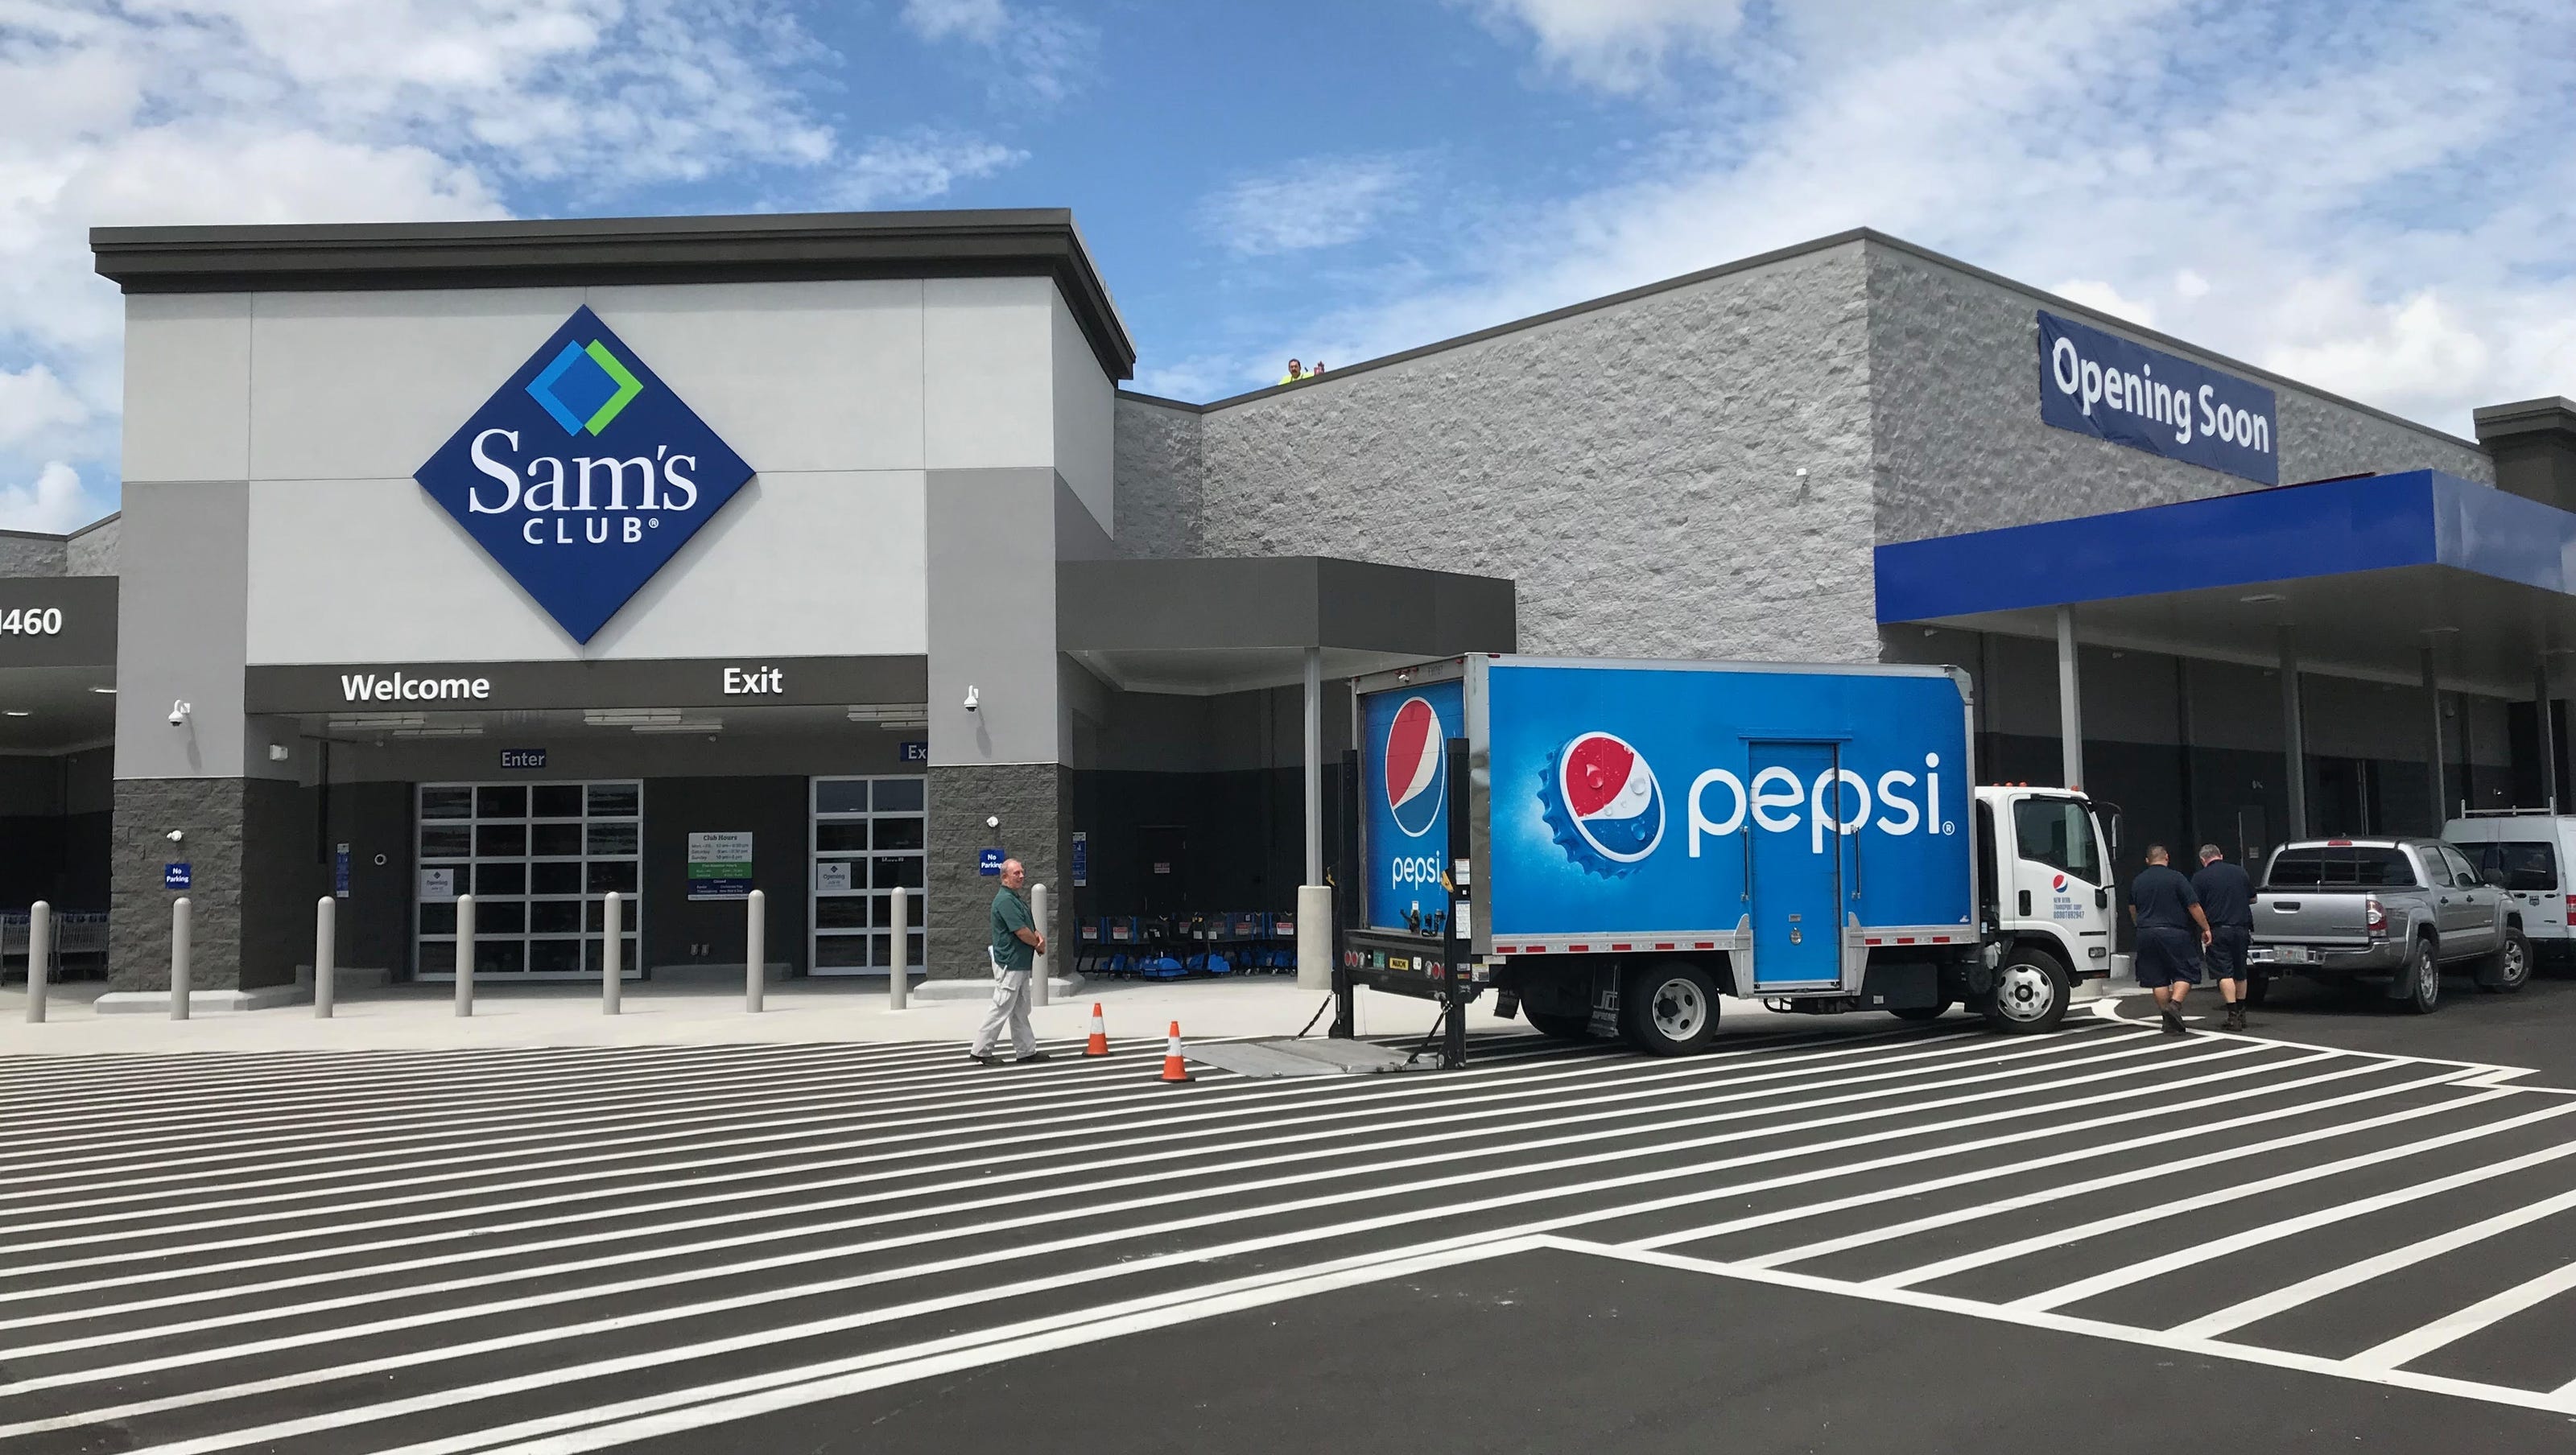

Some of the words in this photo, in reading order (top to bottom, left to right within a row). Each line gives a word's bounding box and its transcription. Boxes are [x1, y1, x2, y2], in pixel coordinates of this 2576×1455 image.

[2053, 336, 2191, 444] Opening
[2198, 384, 2269, 453] Soon
[469, 428, 698, 514] Sam's
[341, 673, 490, 701] Welcome
[723, 666, 783, 695] Exit
[502, 752, 545, 767] Enter
[166, 875, 189, 884] Parking
